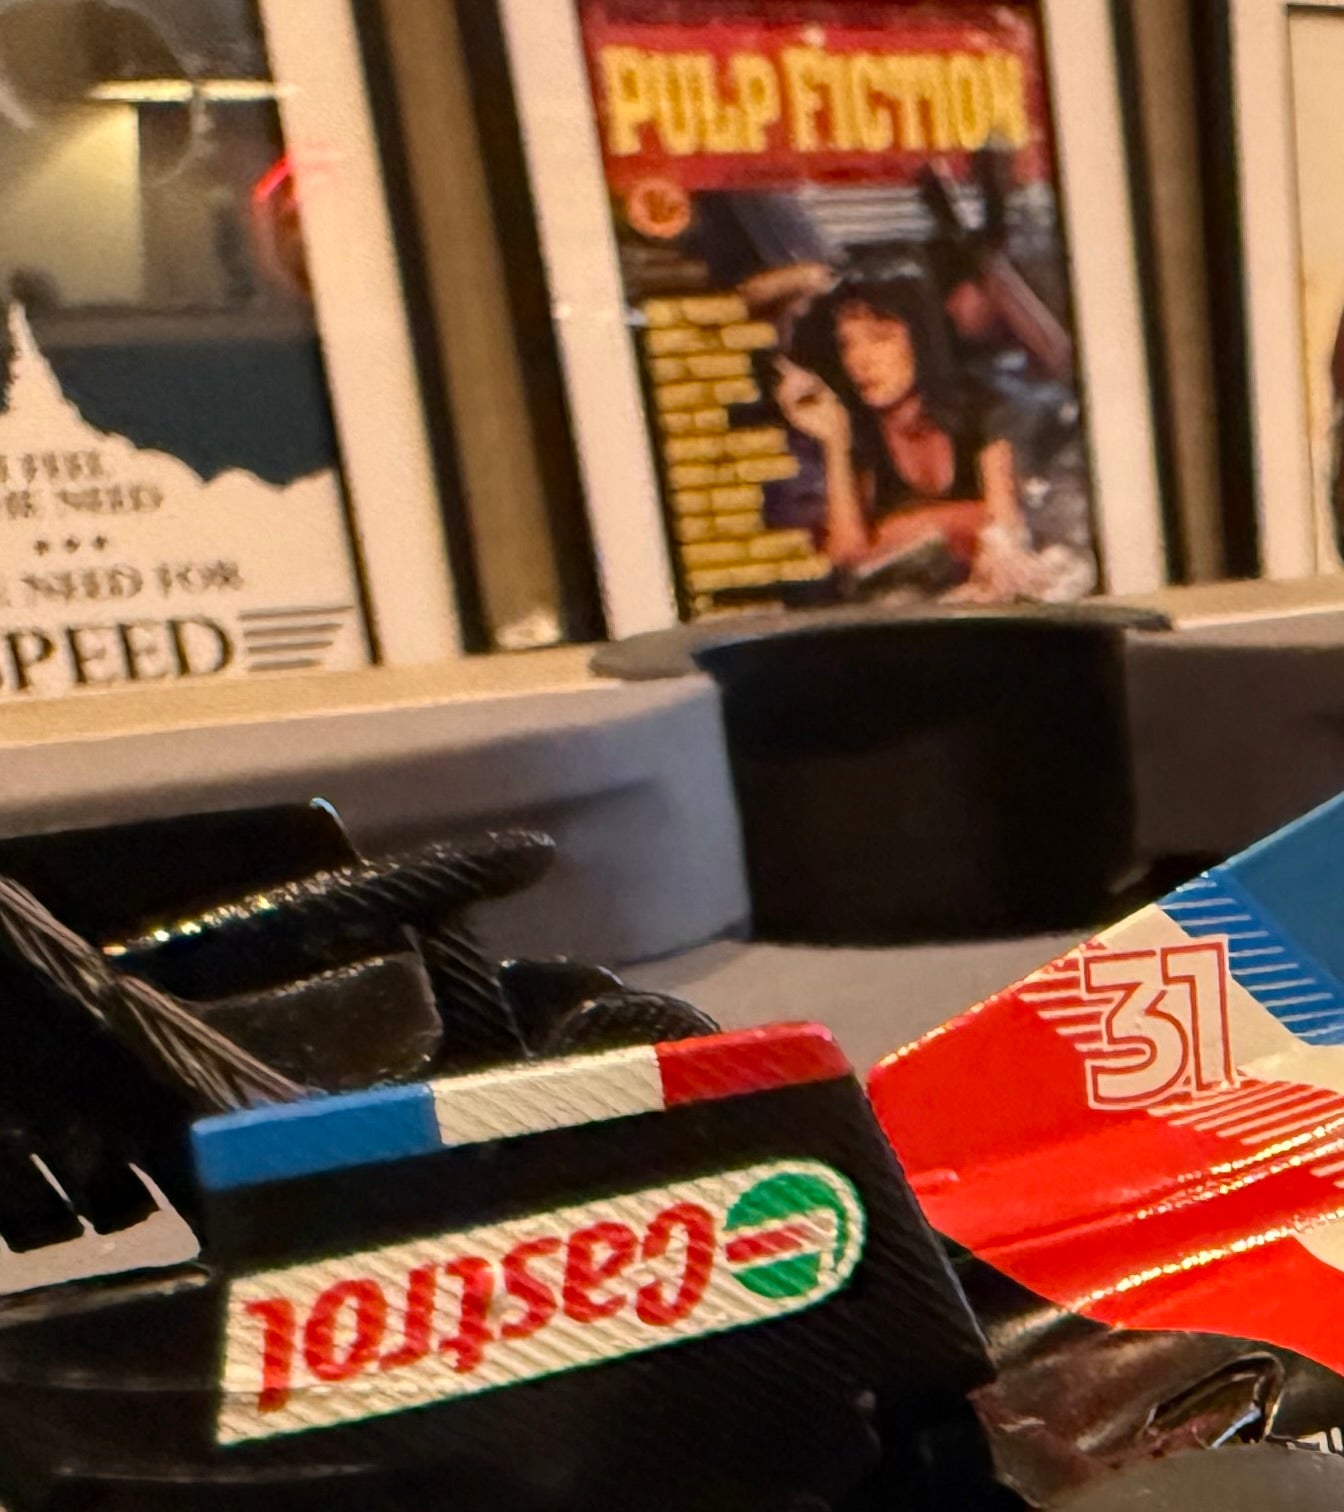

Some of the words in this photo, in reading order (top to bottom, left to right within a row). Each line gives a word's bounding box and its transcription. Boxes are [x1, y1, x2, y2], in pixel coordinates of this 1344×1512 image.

[601, 45, 780, 155] PULP
[782, 47, 1029, 153] FICTION
[0, 614, 236, 692] PEED
[1078, 934, 1242, 1112] 31
[246, 1201, 716, 1413] Castrol
